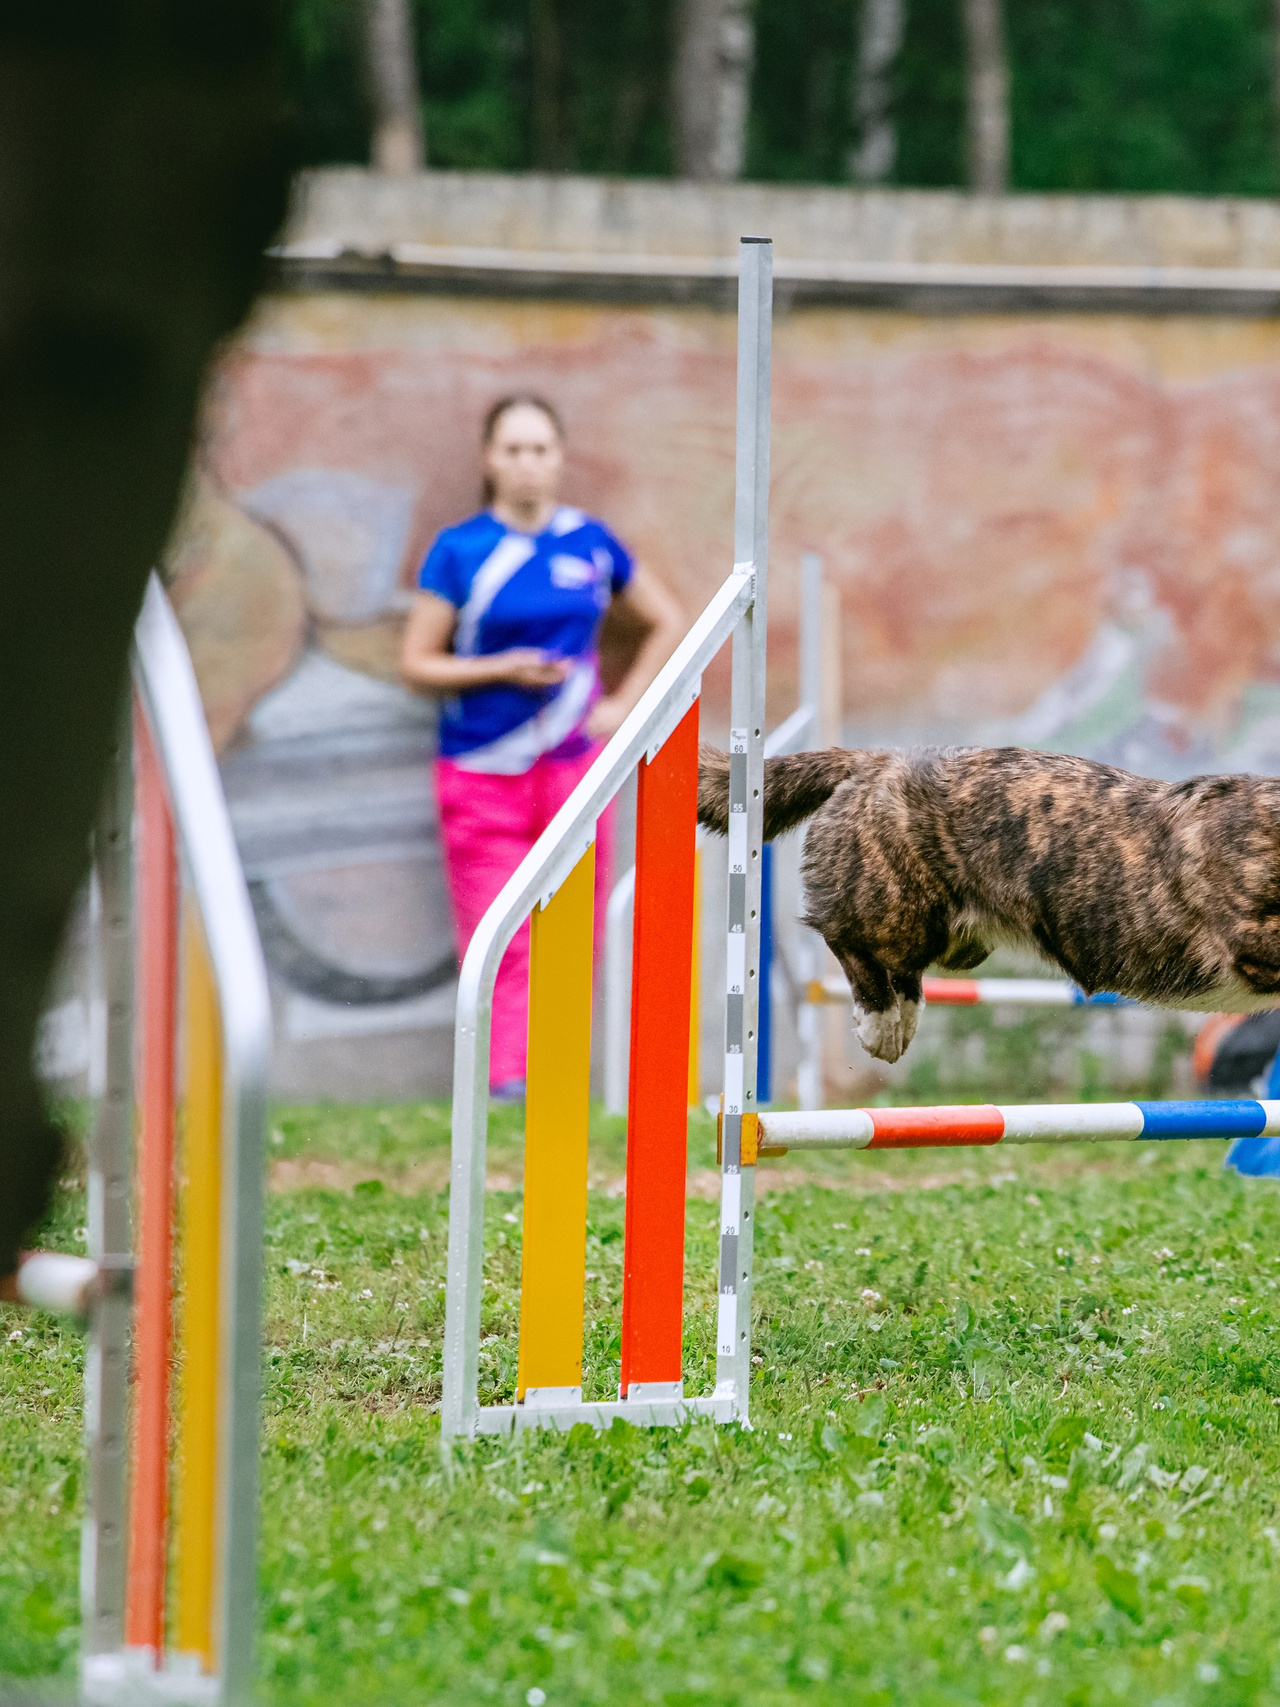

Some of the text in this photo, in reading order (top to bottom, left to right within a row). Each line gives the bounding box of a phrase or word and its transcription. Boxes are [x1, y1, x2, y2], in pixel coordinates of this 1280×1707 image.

[734, 744, 744, 753] 60
[733, 803, 744, 812] 55
[733, 864, 742, 873] 50
[731, 924, 742, 933] 45
[731, 985, 740, 993] 40
[729, 1044, 740, 1053] 35
[729, 1105, 738, 1114] 30
[727, 1165, 738, 1174] 25
[725, 1226, 735, 1235] 20
[723, 1285, 733, 1294] 15
[722, 1345, 730, 1354] 10
